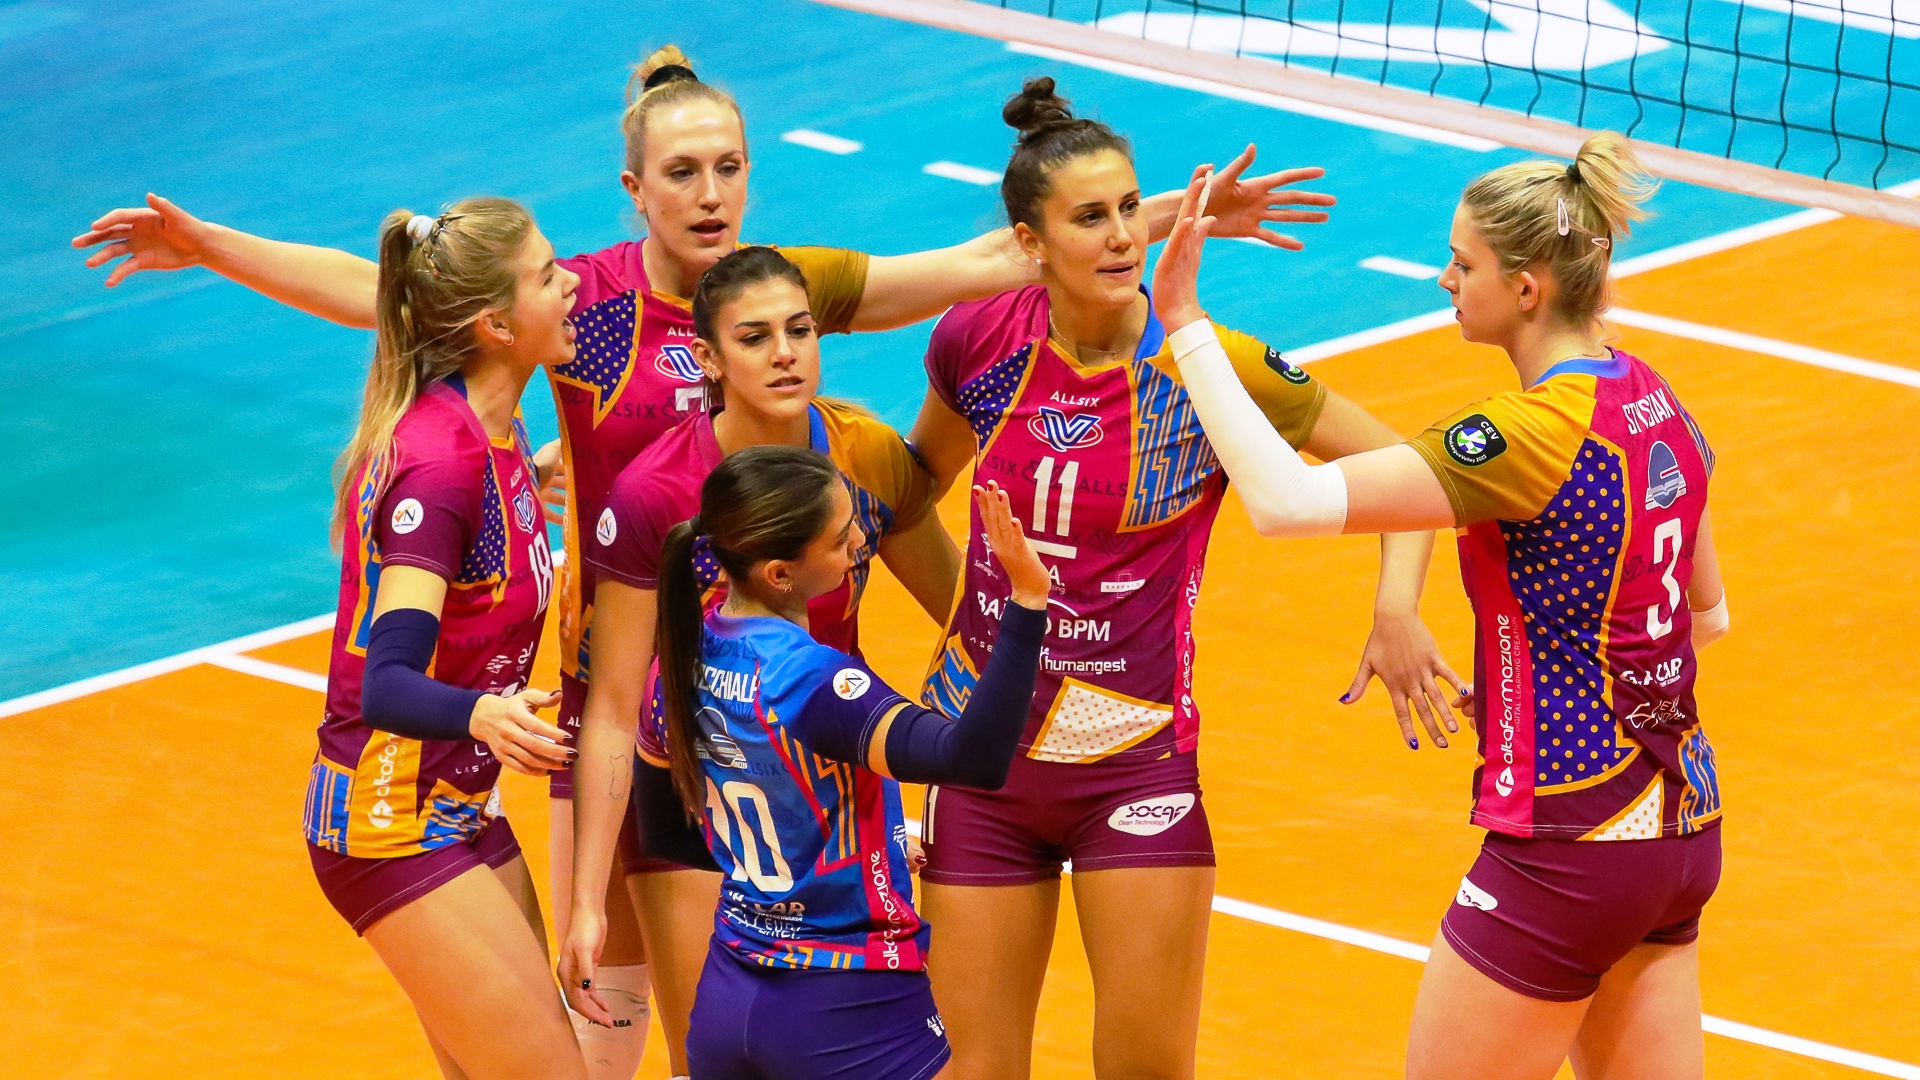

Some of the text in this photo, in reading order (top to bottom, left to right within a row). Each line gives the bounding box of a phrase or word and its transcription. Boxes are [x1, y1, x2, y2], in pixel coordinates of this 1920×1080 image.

[1050, 391, 1100, 408] ALLSIX
[1622, 388, 1675, 435] STYSIAK
[1480, 421, 1500, 441] CEV
[1032, 456, 1080, 537] 11
[528, 530, 554, 623] 18
[1646, 517, 1683, 641] 3
[1058, 618, 1111, 642] BPM
[1511, 615, 1521, 657] CREATION
[1044, 656, 1127, 675] humangest
[1498, 613, 1514, 765] altaformazione
[705, 775, 794, 891] 10
[1118, 819, 1166, 827] Clean Technology
